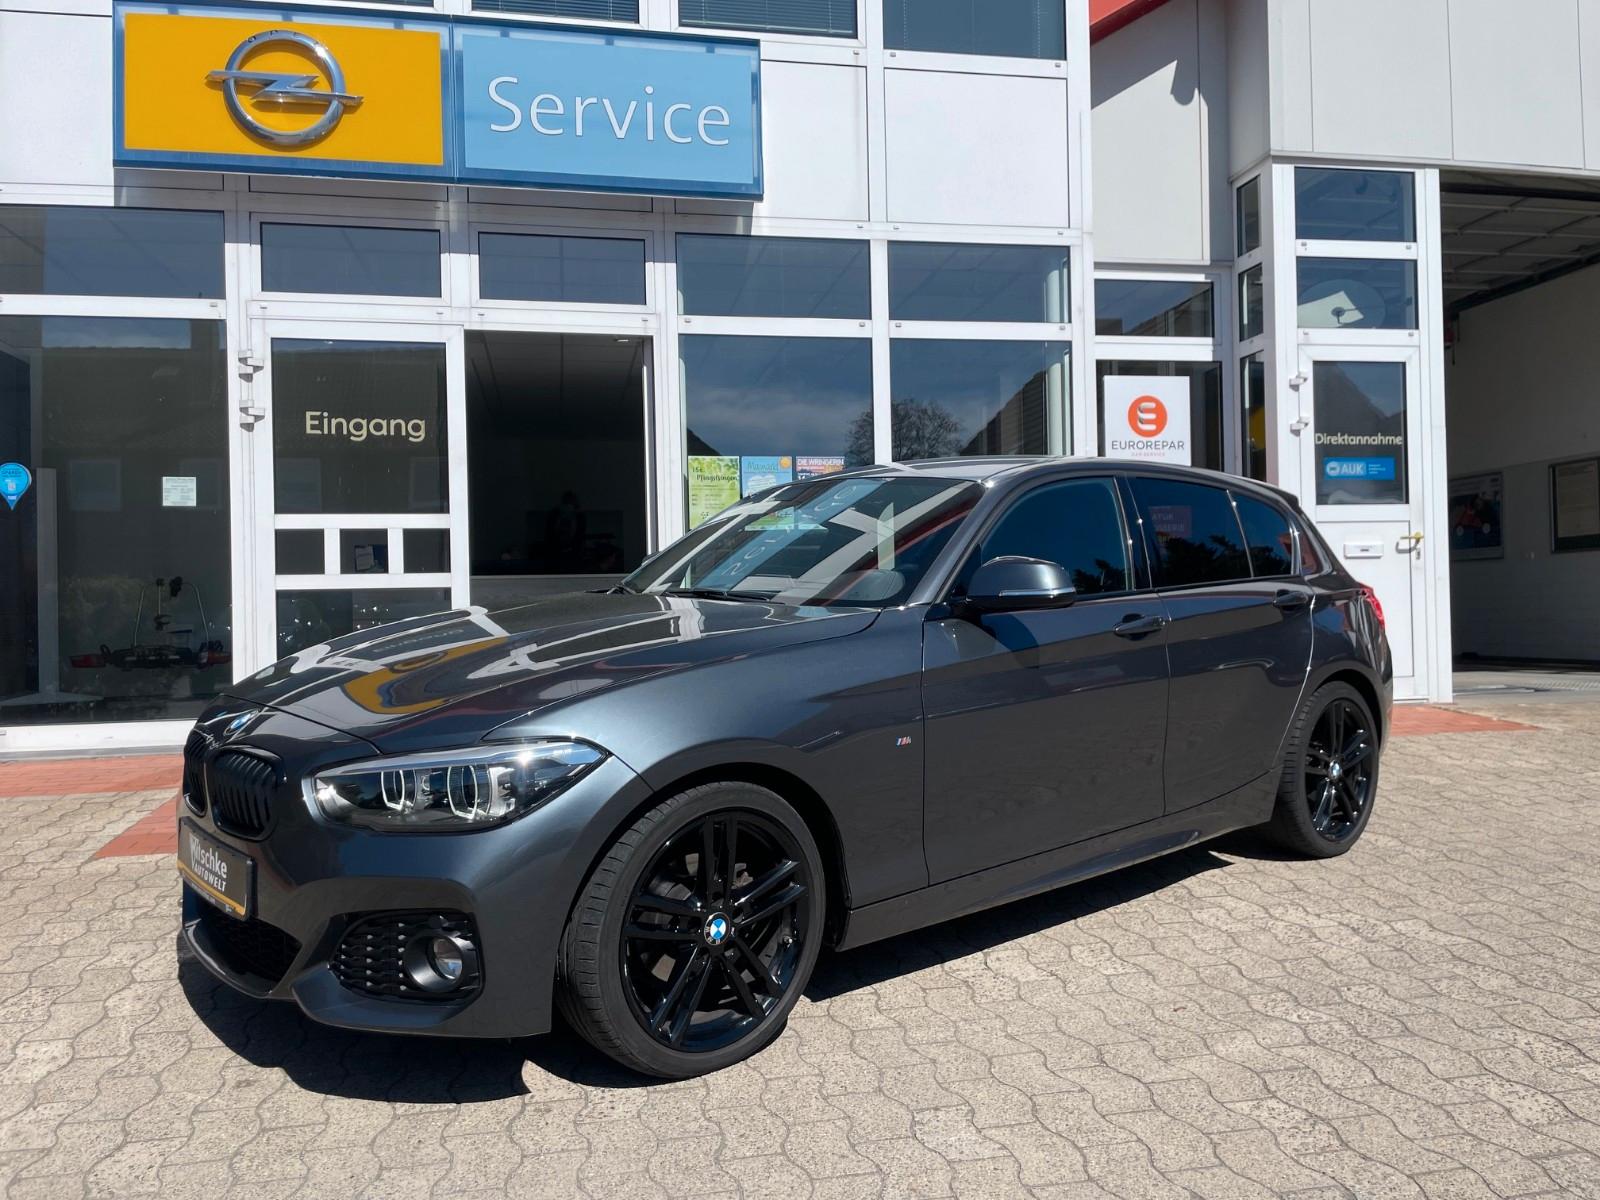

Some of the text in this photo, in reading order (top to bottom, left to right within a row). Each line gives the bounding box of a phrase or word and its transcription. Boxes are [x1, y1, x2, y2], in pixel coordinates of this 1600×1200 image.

[488, 76, 730, 146] Service
[305, 410, 426, 442] Eingang
[1111, 440, 1185, 450] EUROREPAR
[1314, 432, 1403, 445] Direktannahme
[1341, 463, 1364, 475] AUK
[194, 863, 227, 893] AUTOWELT
